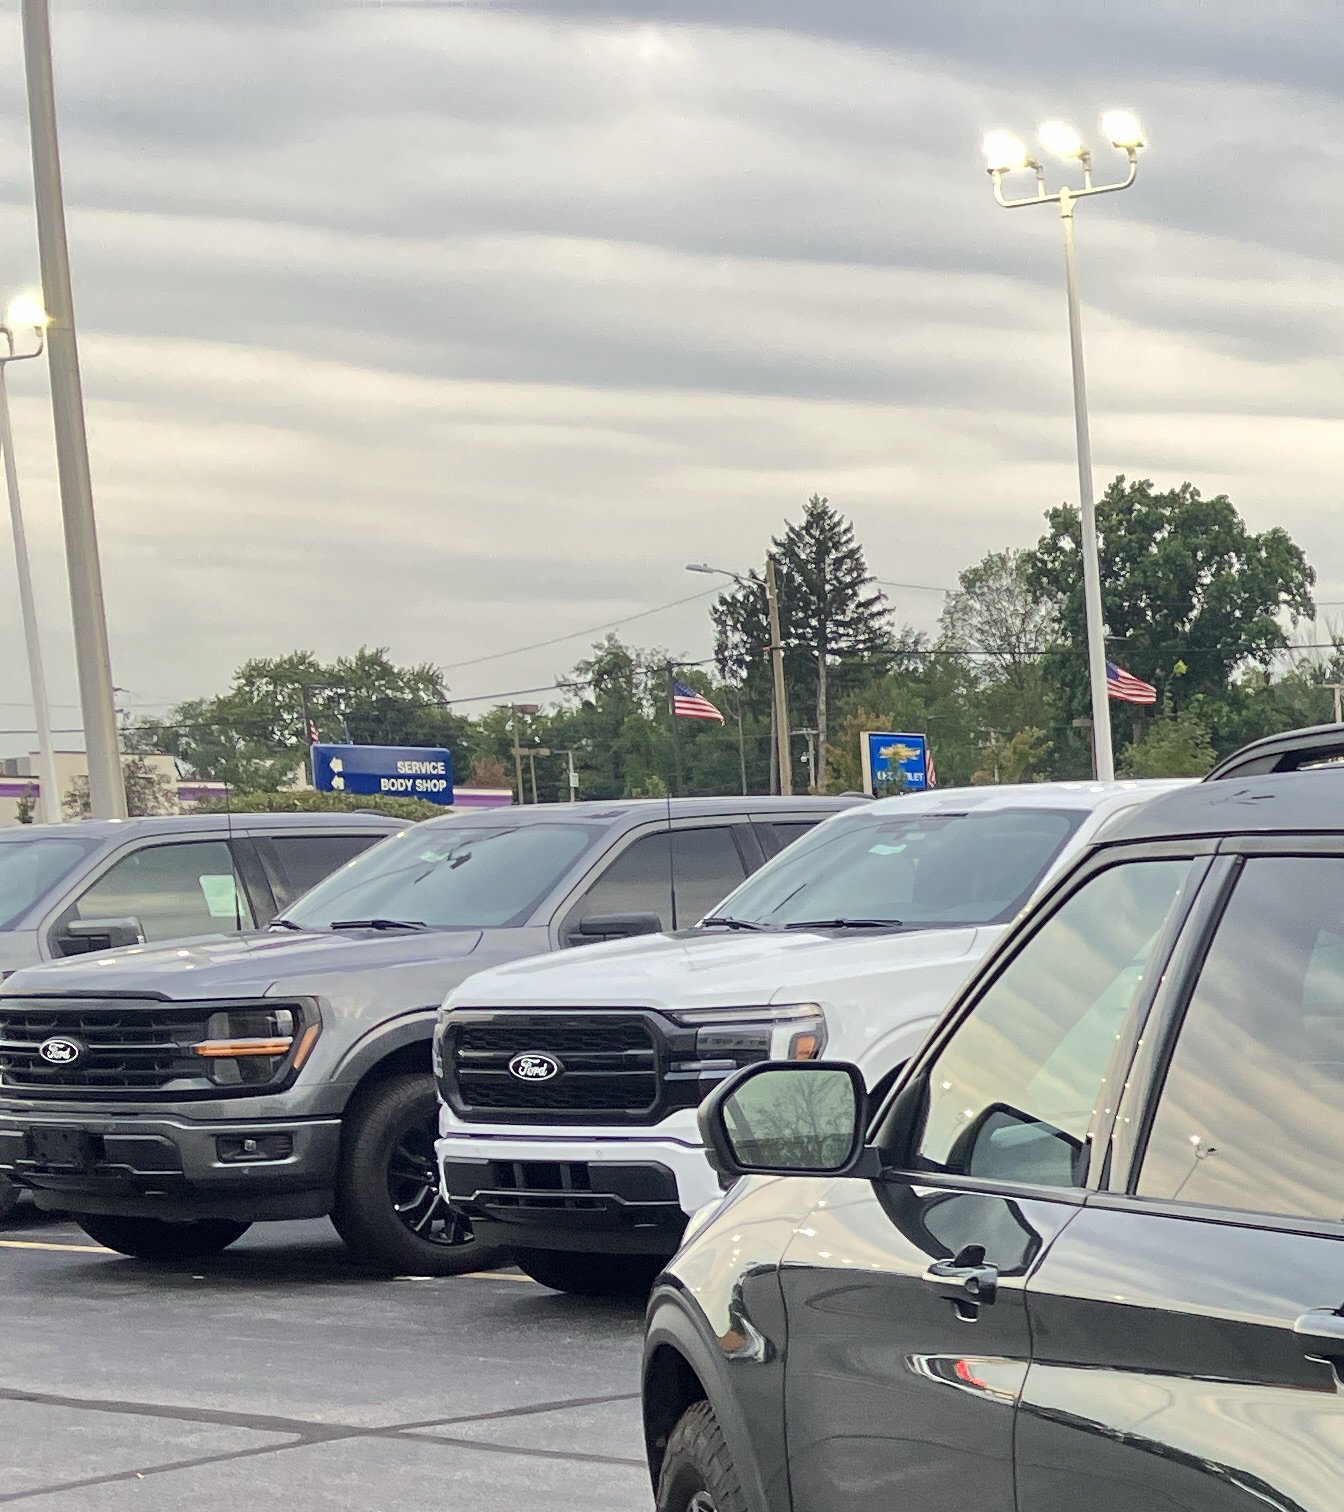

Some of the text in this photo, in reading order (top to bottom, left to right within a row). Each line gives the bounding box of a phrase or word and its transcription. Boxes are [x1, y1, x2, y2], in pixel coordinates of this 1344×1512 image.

[397, 761, 446, 775] SERVICE
[380, 778, 447, 792] BODY SHOP
